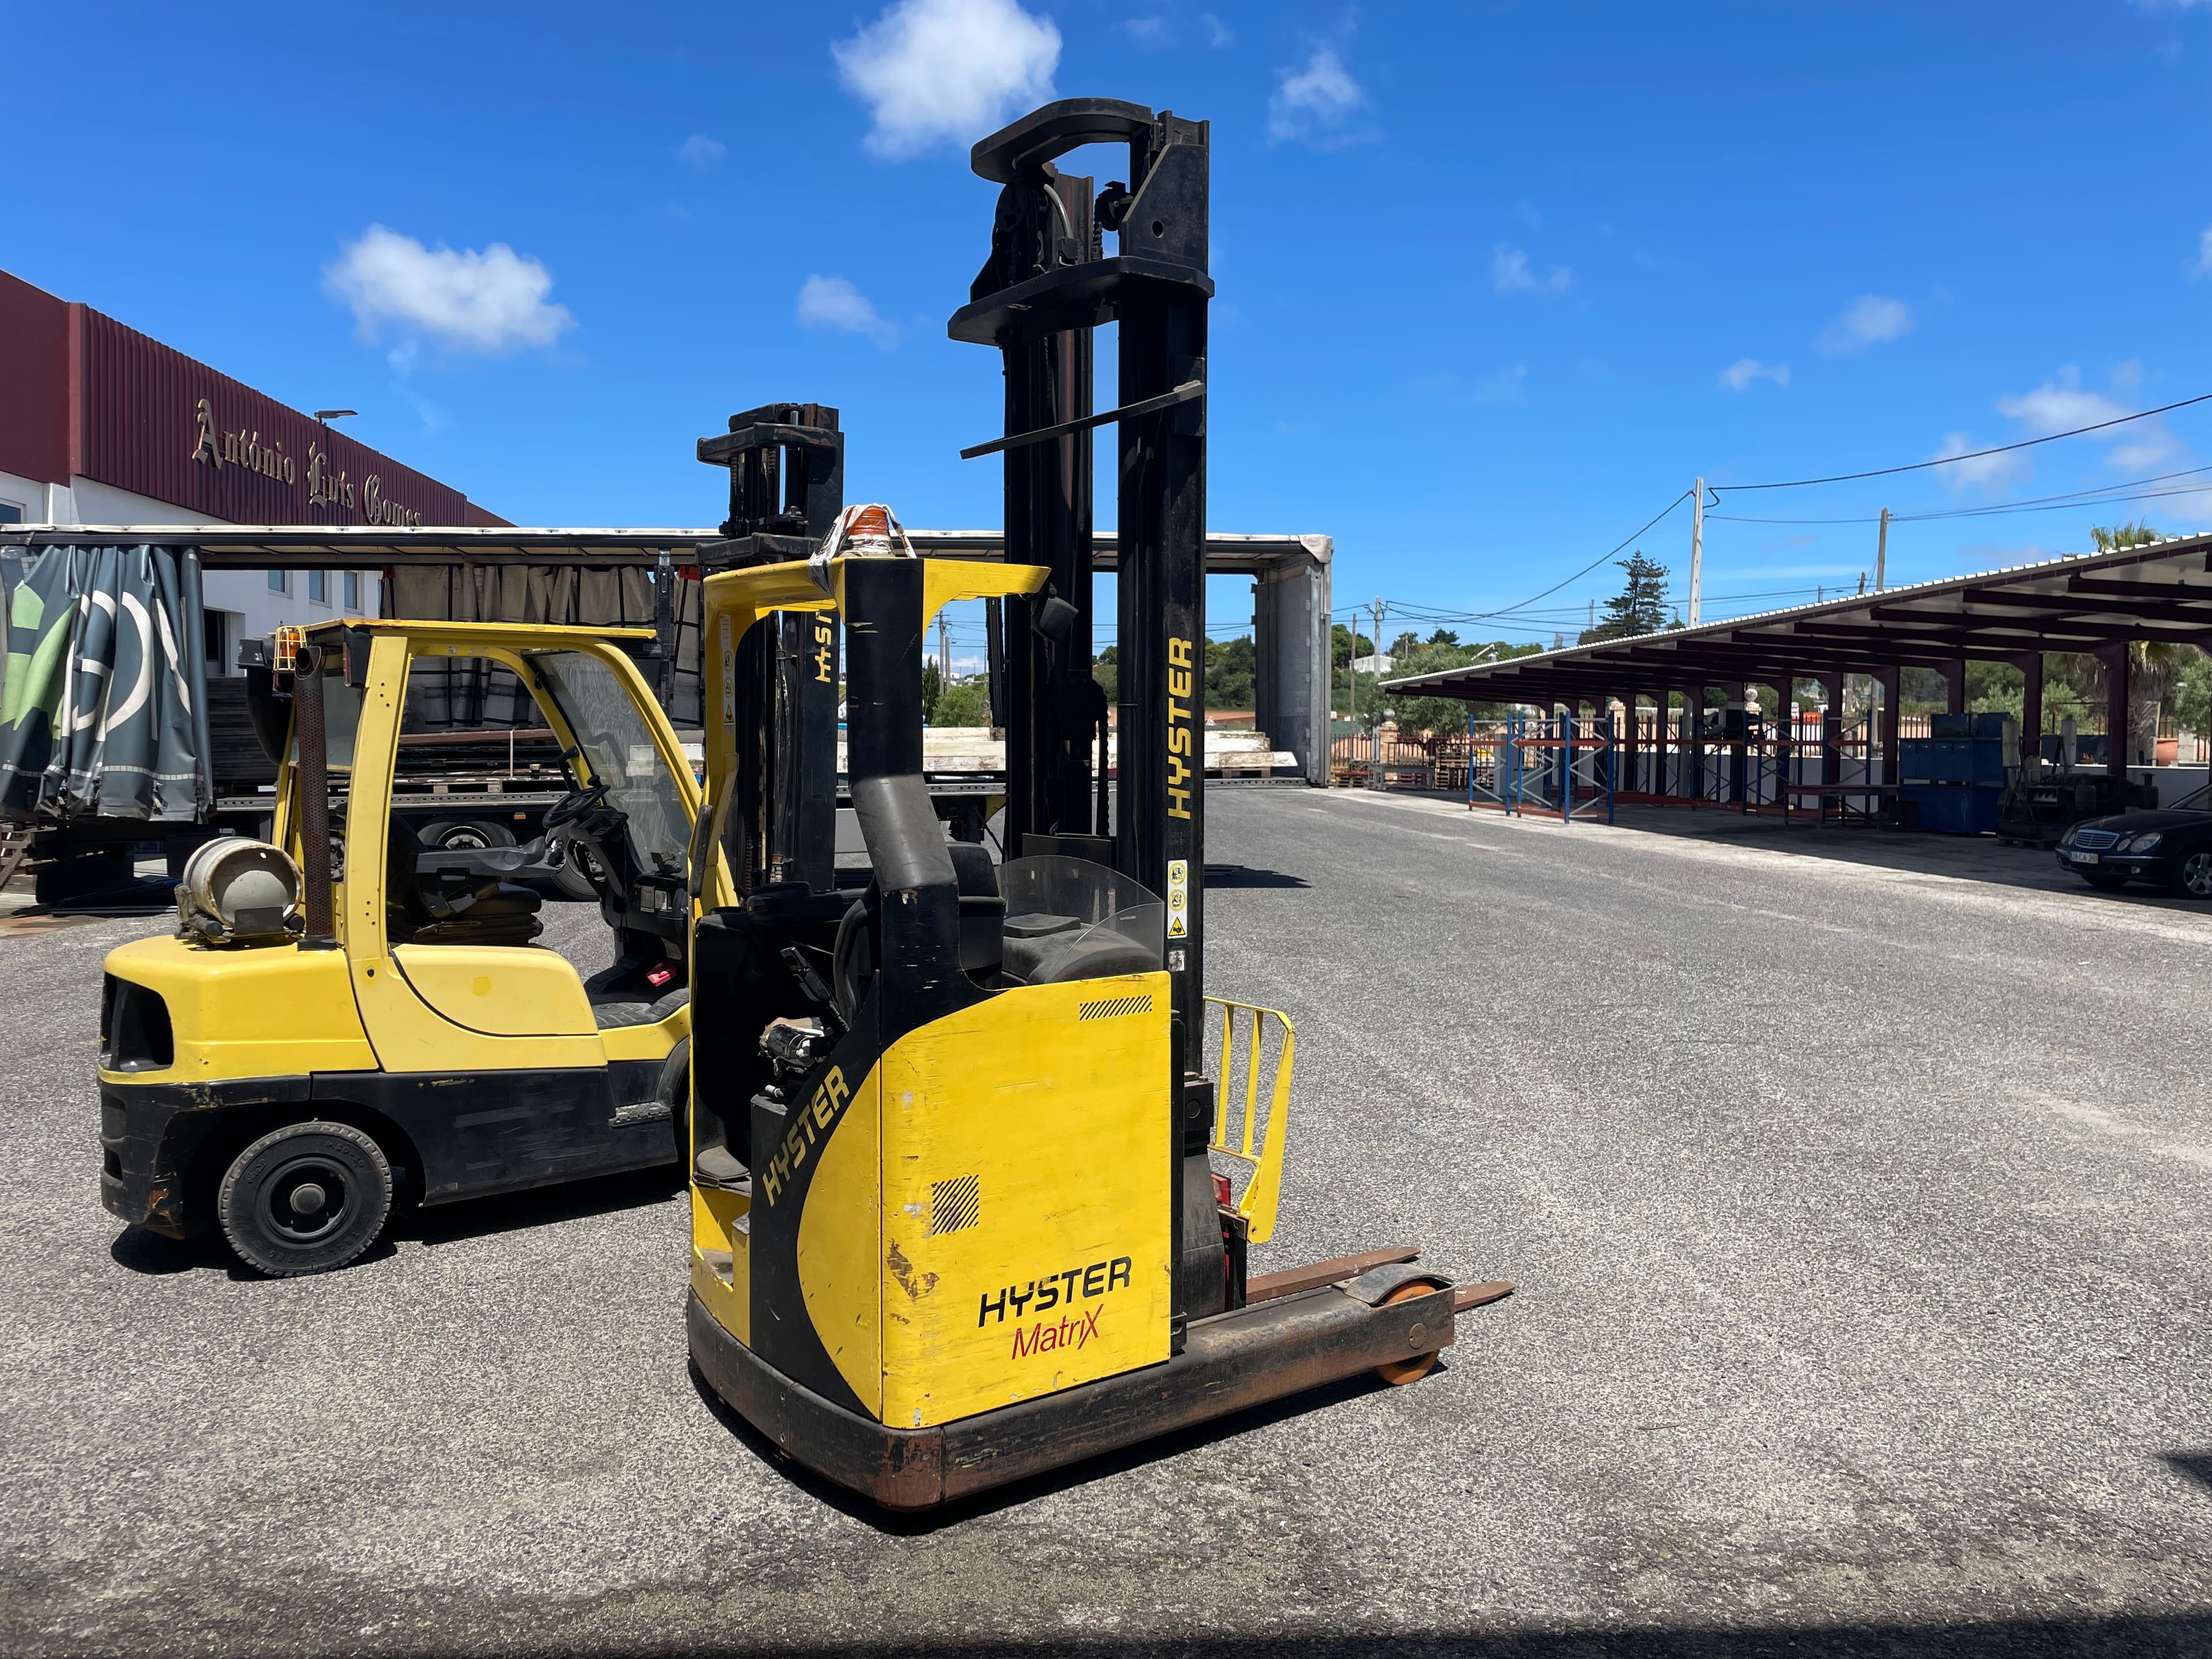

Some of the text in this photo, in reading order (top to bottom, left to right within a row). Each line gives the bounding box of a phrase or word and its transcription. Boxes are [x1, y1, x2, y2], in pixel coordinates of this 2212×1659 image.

[192, 399, 421, 527] António Luís Gomes
[1168, 637, 1192, 820] HYSTER
[762, 1065, 850, 1207] HYSTER
[978, 1256, 1132, 1328] HYSTER
